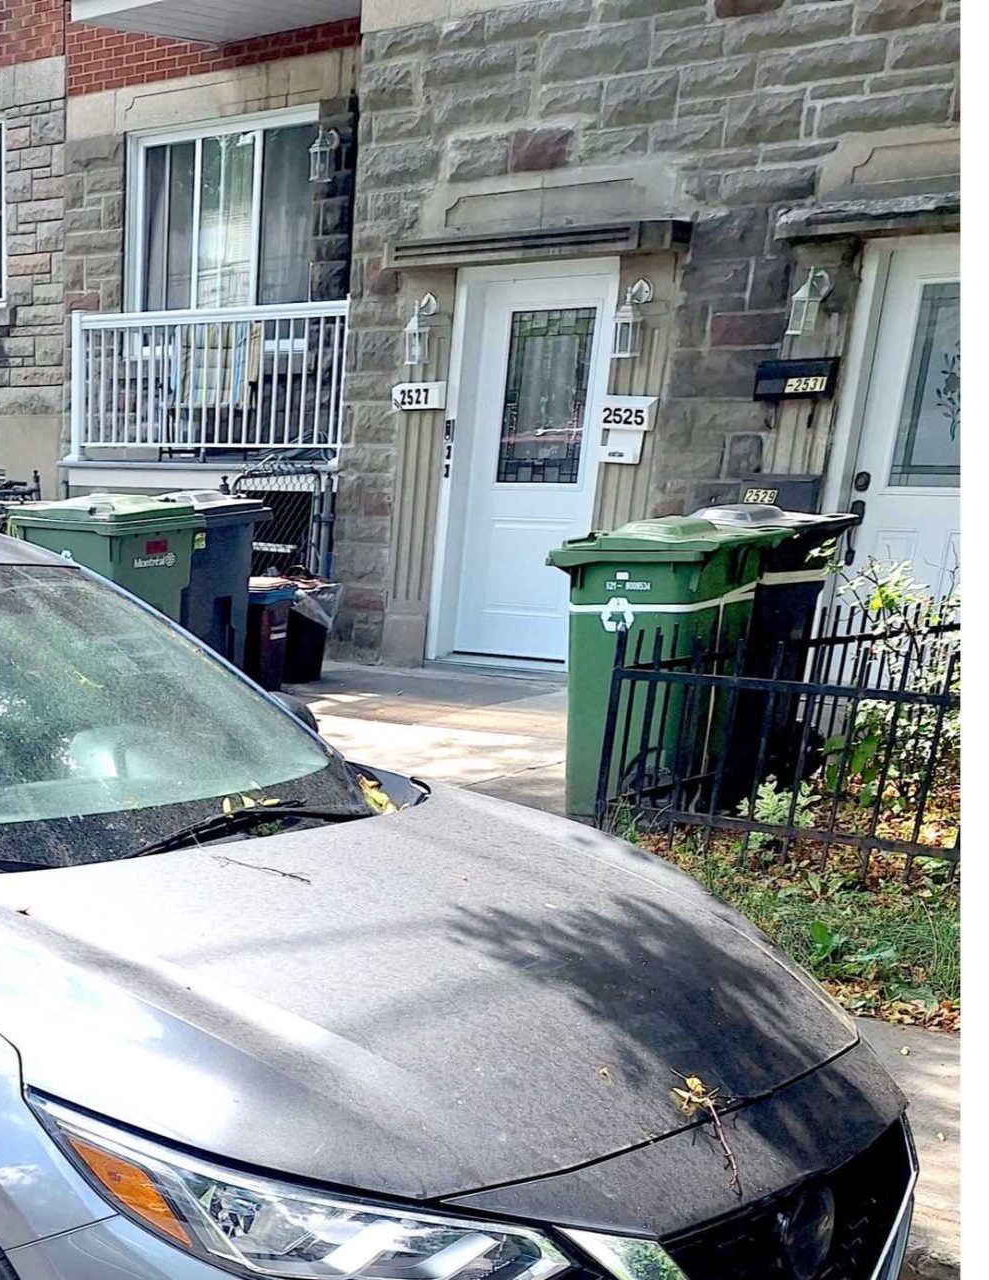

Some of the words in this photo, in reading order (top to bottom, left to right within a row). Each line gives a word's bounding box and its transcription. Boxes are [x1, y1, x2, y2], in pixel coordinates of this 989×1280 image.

[400, 388, 429, 406] 2527
[602, 407, 645, 426] 2525
[745, 490, 776, 503] 2529
